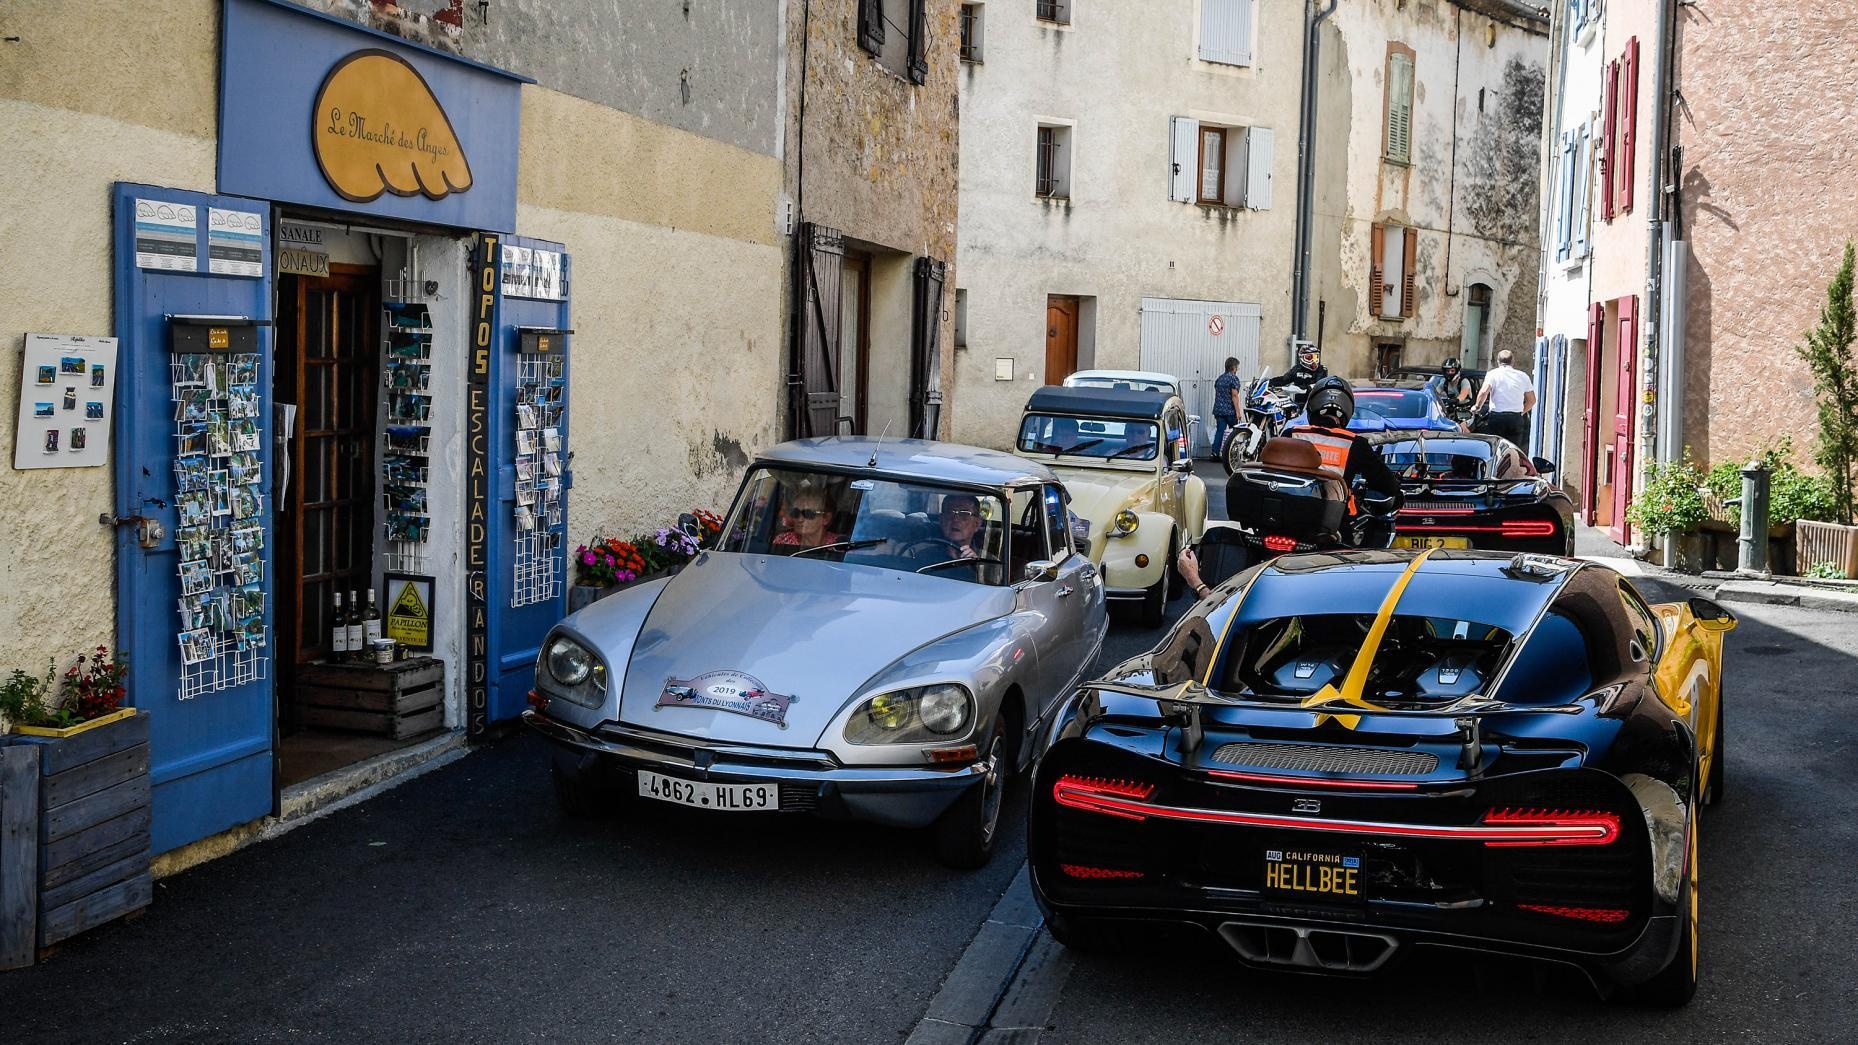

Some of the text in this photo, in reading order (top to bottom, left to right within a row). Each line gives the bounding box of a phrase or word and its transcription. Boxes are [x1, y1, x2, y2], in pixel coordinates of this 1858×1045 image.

[328, 107, 448, 164] Le Marché des Anges
[280, 226, 322, 242] SANALE
[280, 250, 328, 274] ONAUX
[471, 237, 497, 735] TOPOS ESCALADE RANDOS
[712, 686, 736, 695] 2019
[712, 698, 721, 706] DU
[721, 699, 752, 711] LYONNAIS
[650, 775, 767, 808] 4862 HL69
[1267, 851, 1282, 860] AUG
[1285, 851, 1341, 863] CALIFORNIA
[1266, 862, 1358, 895] HELLBEE
